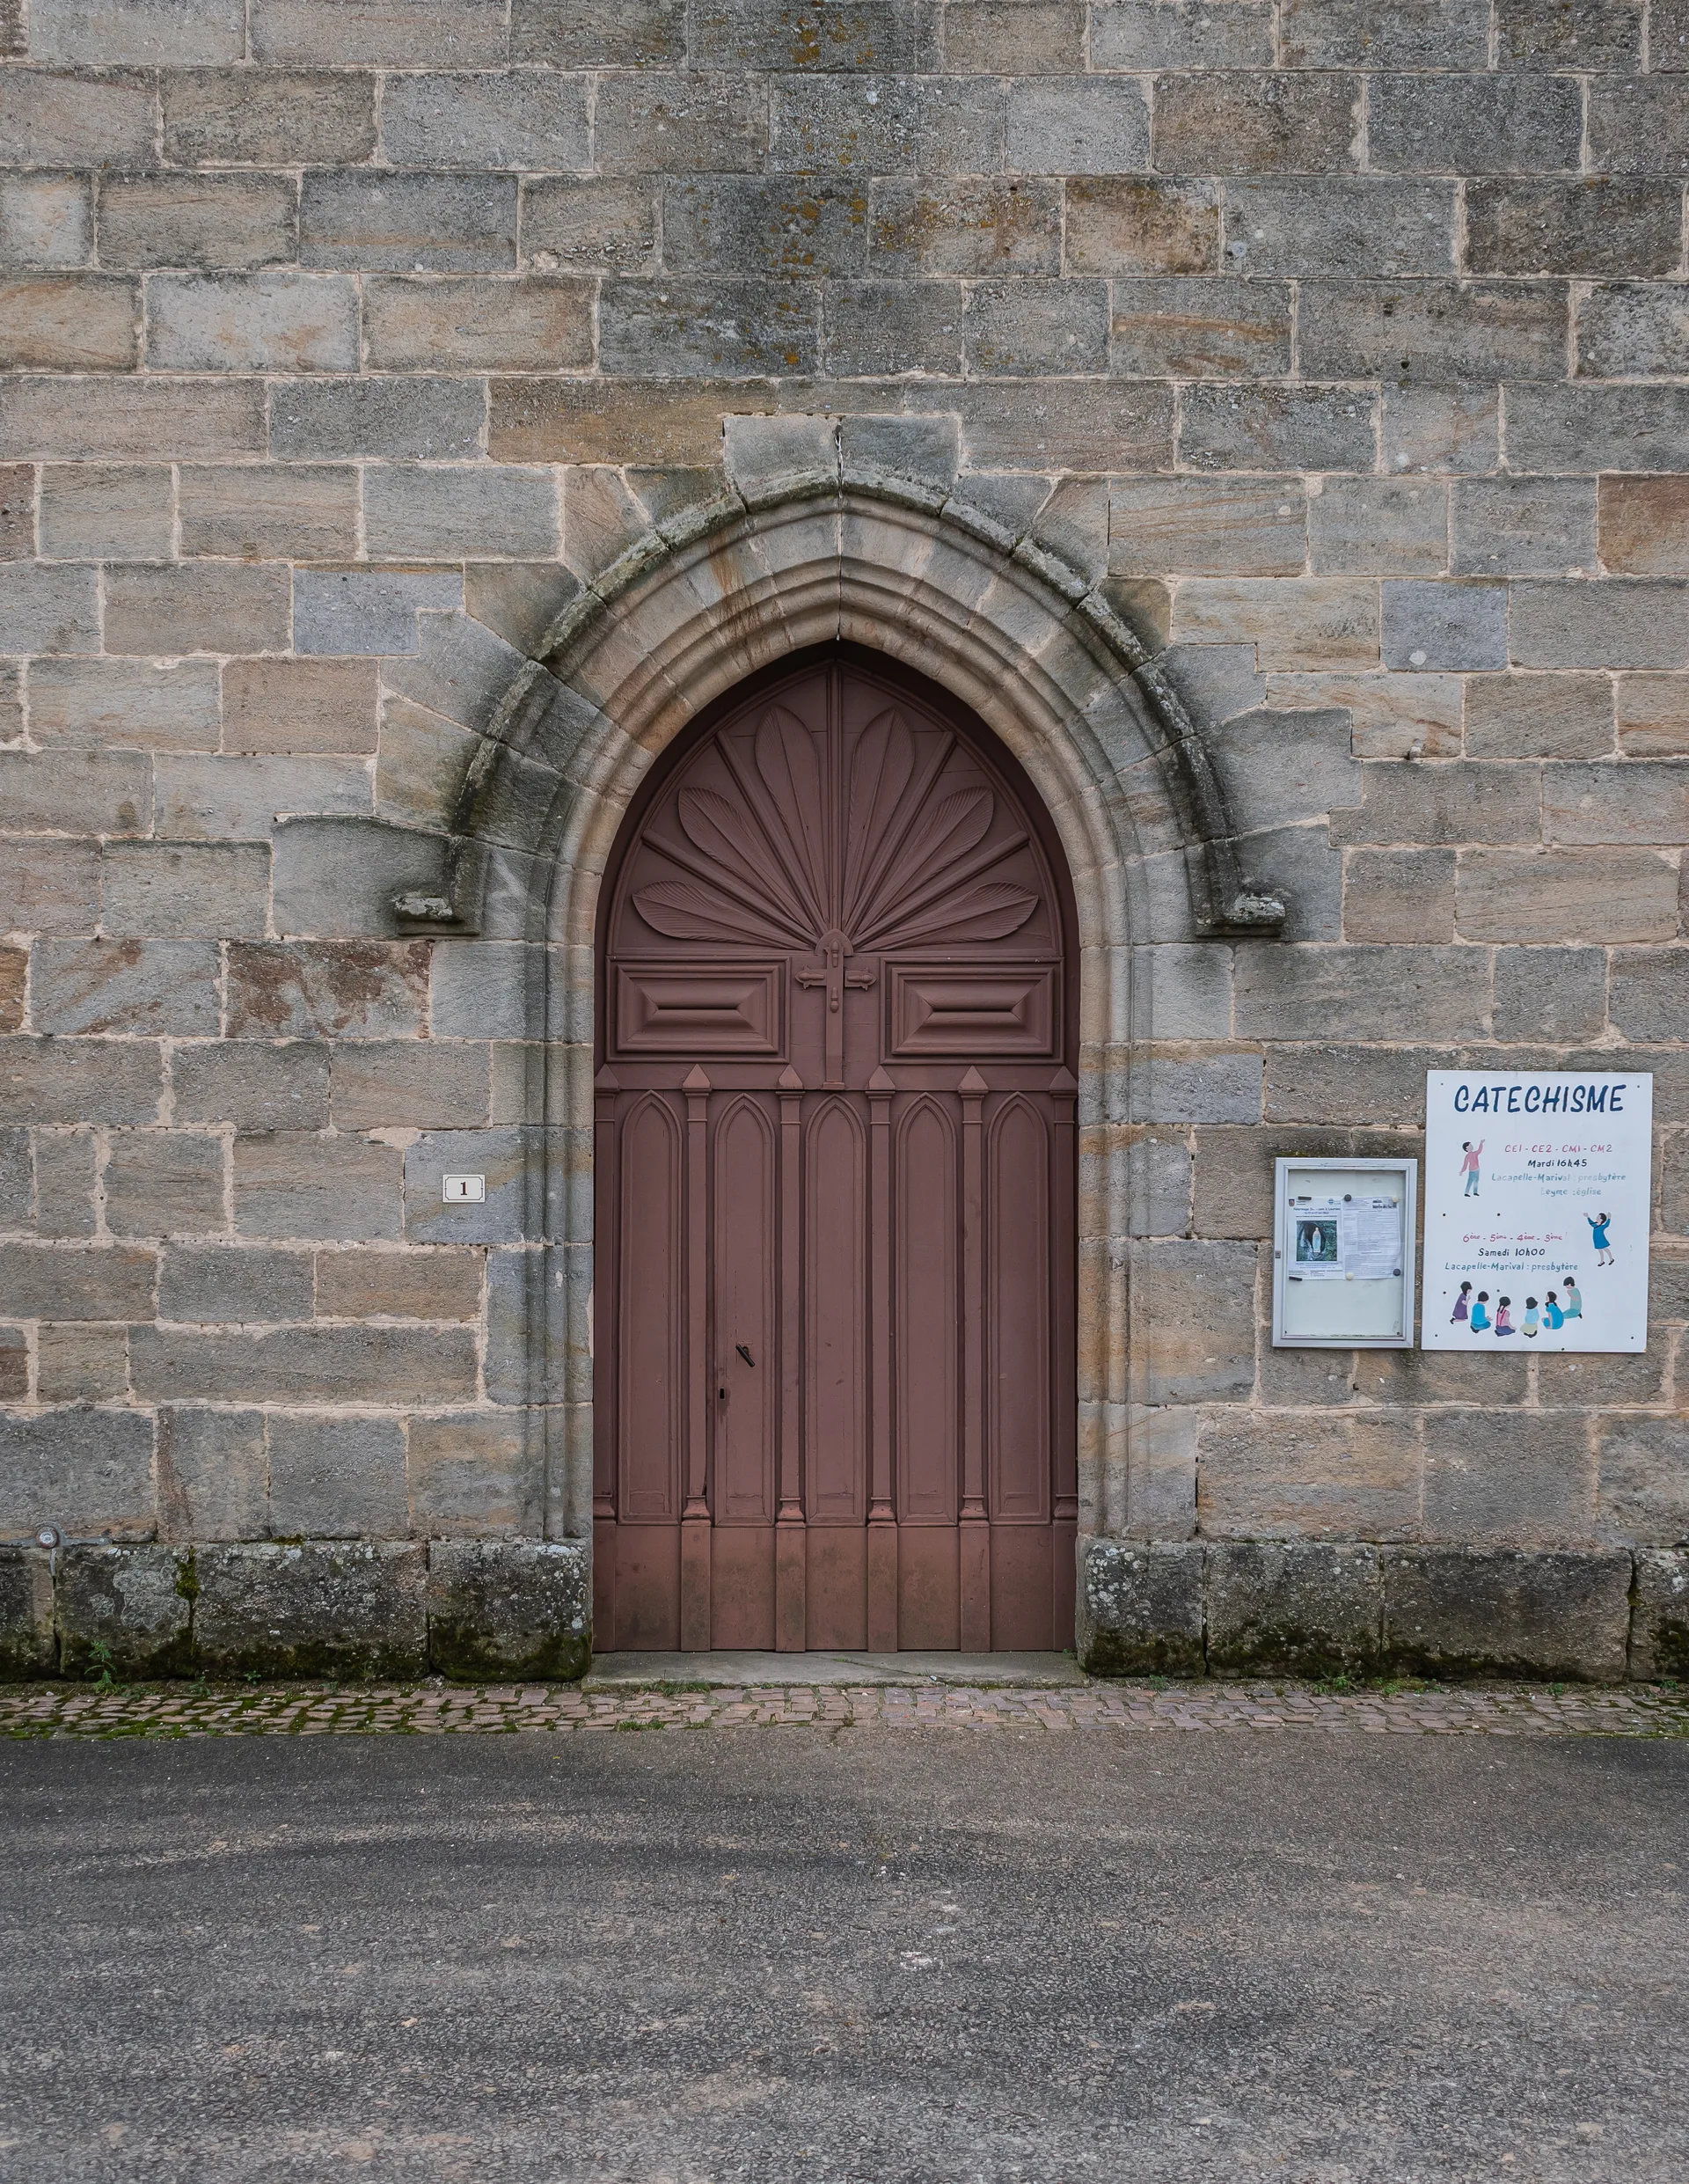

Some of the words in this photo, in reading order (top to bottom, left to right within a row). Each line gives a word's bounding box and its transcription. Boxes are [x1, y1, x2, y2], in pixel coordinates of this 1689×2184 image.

[1454, 1084, 1627, 1113] CATECHISME
[1532, 1144, 1552, 1153] CE2
[1590, 1144, 1612, 1153] CM2
[1527, 1159, 1554, 1168] Mardi
[1557, 1158, 1588, 1168] 16h45
[460, 1181, 468, 1196] 1
[1478, 1247, 1510, 1257] Samedi
[1515, 1247, 1546, 1257] 10h00
[1444, 1262, 1524, 1272] Lacapelle-Marival
